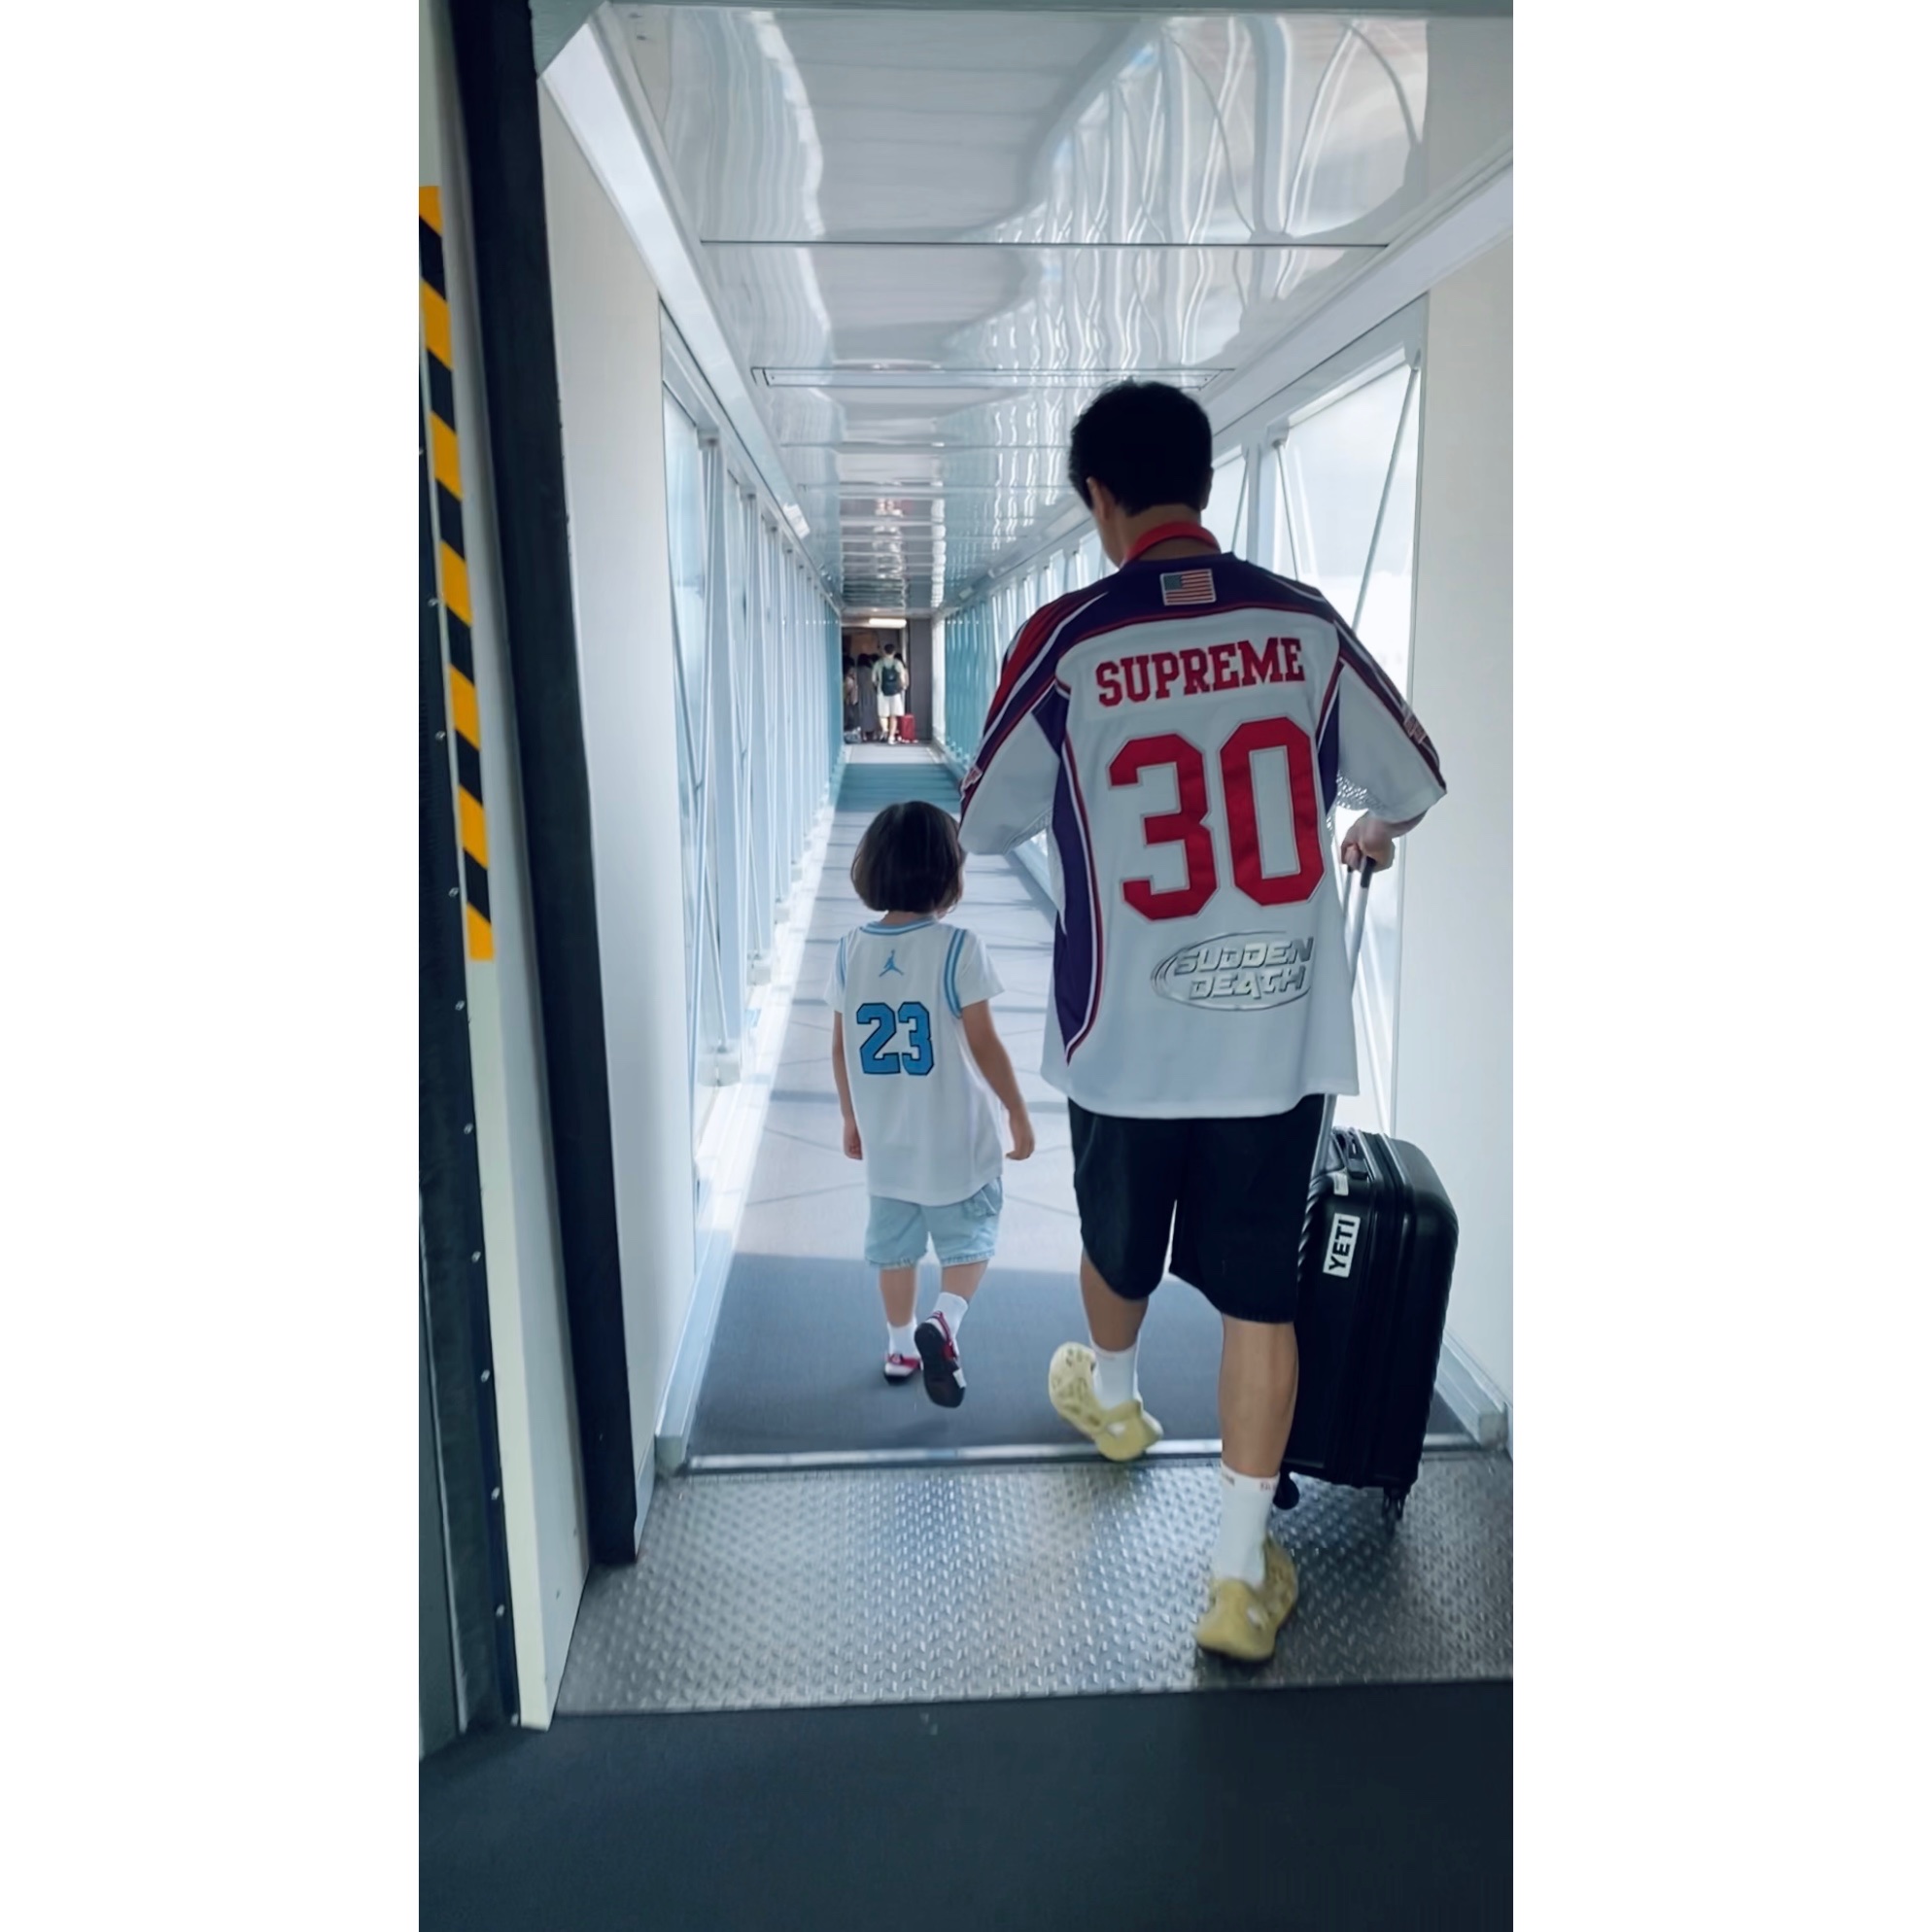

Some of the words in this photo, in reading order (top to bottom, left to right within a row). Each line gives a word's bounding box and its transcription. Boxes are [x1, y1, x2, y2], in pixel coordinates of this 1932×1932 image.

[1095, 637, 1306, 707] SUPREME
[1107, 716, 1325, 921] 30
[1174, 936, 1314, 977] SUDDEN
[1189, 965, 1306, 1001] DEATH
[856, 1001, 934, 1077] 23
[1328, 1219, 1356, 1271] YETI
